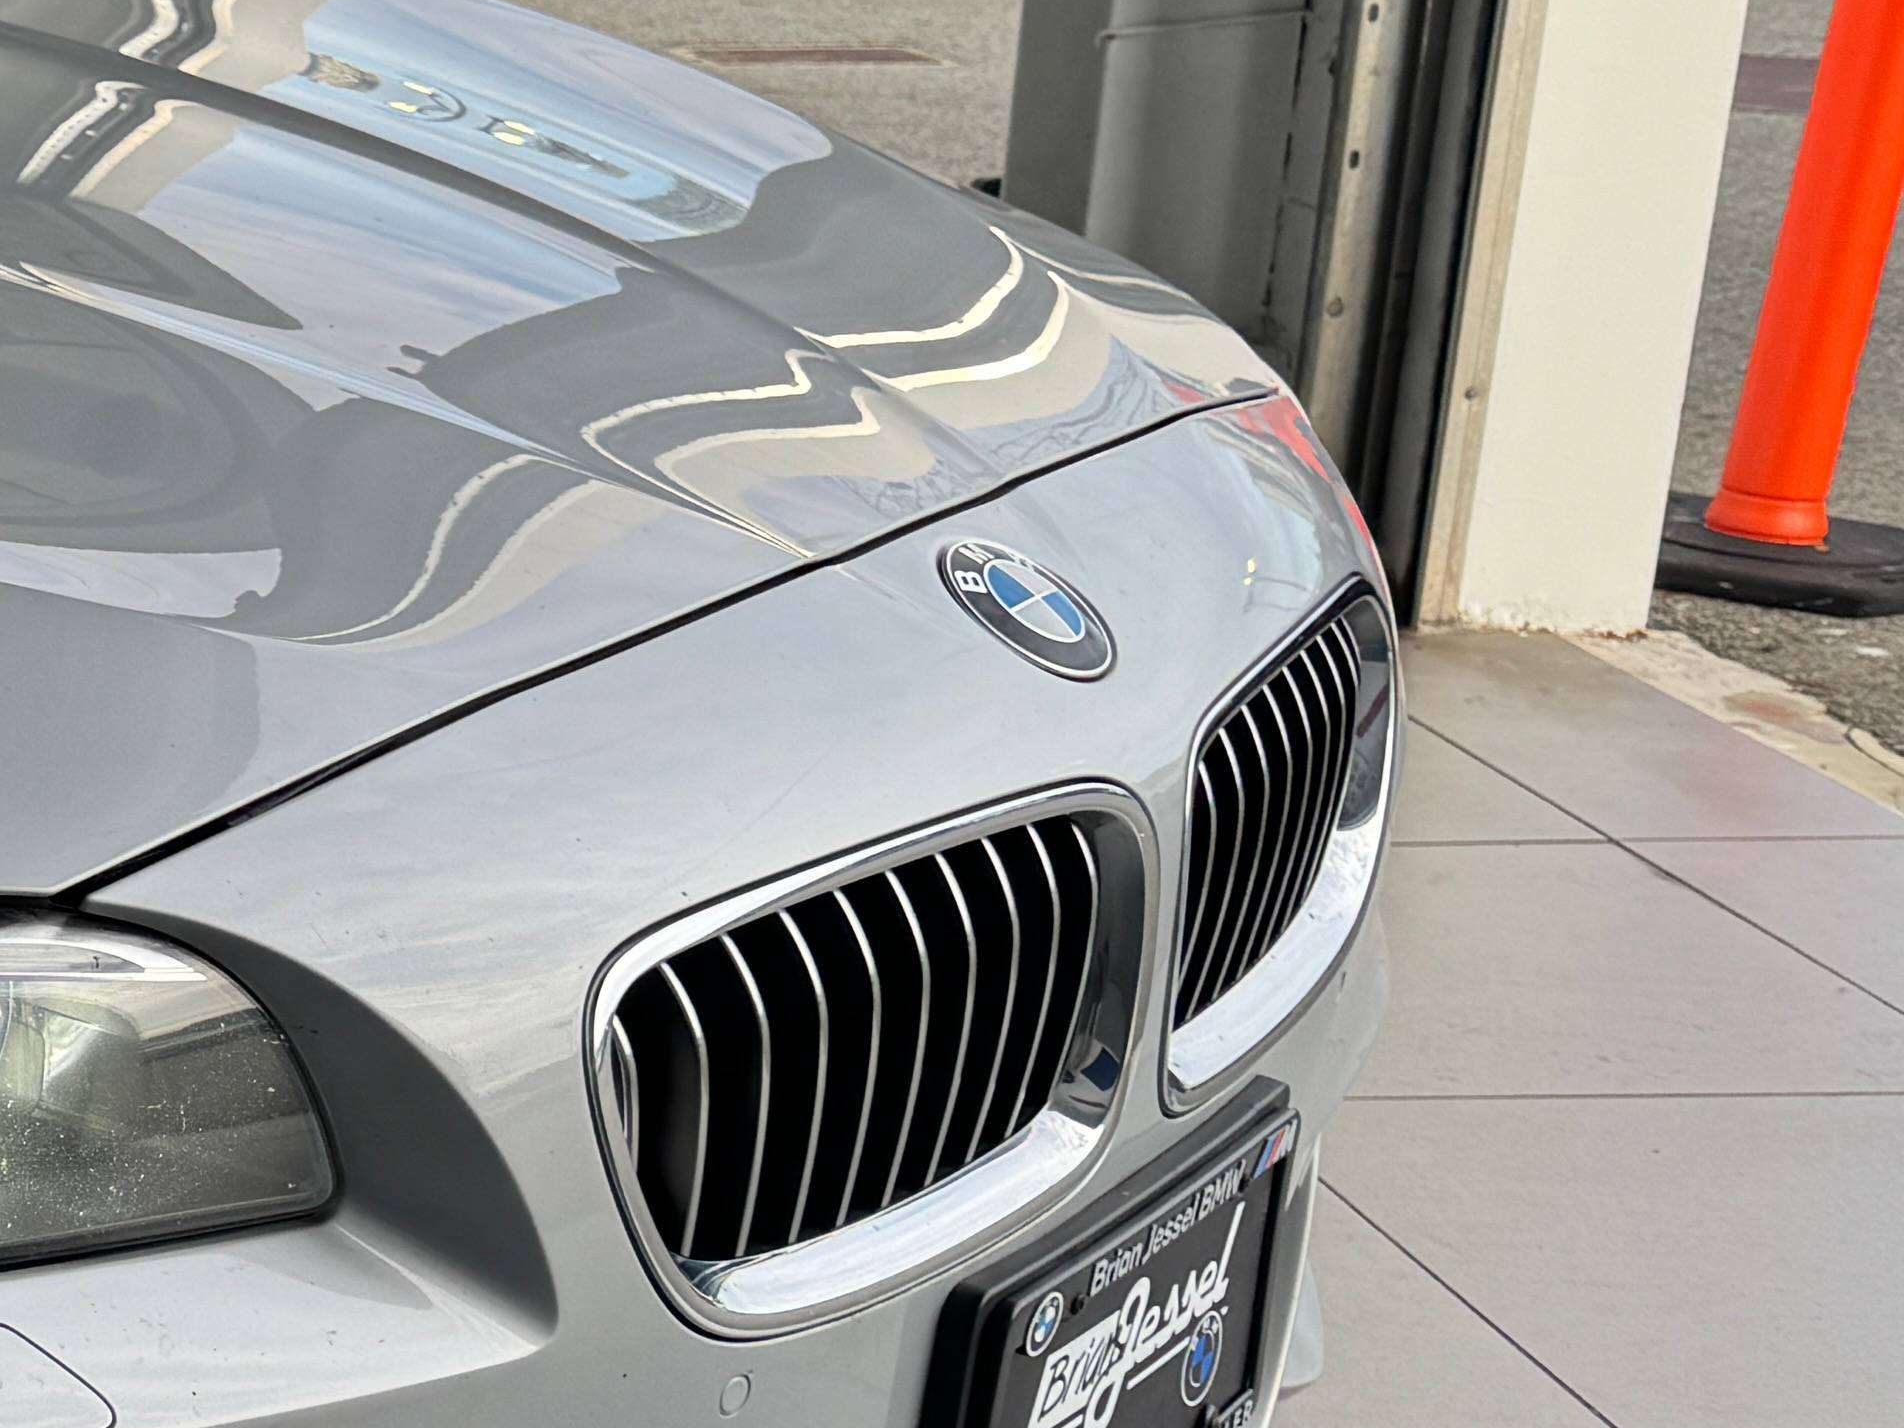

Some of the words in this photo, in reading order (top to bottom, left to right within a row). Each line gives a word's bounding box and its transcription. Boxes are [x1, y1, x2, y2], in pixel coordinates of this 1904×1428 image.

[1090, 1242, 1144, 1297] Brian
[1142, 1192, 1201, 1264] Jessel
[1198, 1159, 1246, 1221] BMW
